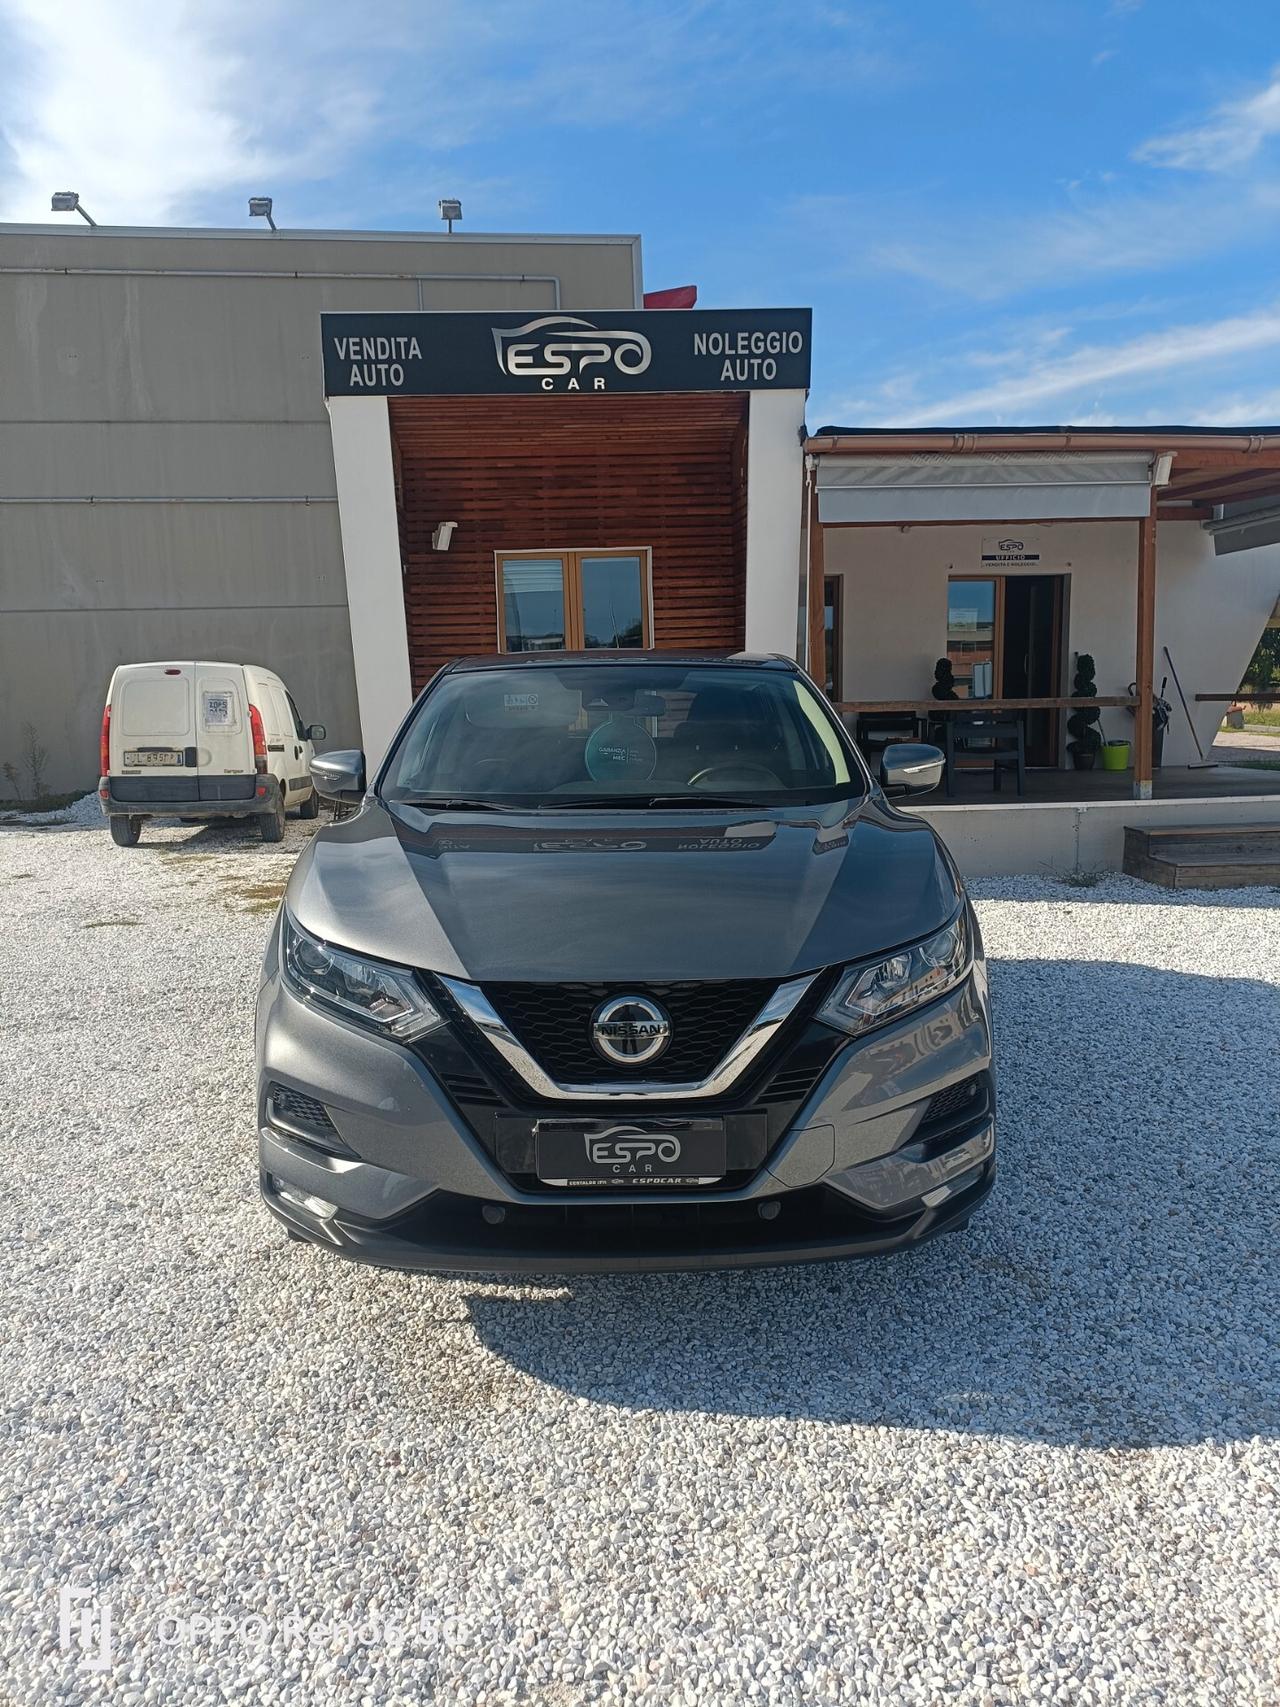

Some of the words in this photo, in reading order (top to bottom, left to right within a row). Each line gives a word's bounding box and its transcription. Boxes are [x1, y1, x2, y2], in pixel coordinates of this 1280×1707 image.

[333, 336, 422, 361] VENDITA
[506, 334, 652, 376] ESPO
[694, 331, 803, 356] NOLEGGIO
[349, 363, 405, 387] AUTO
[720, 358, 777, 382] AUTO
[541, 377, 606, 390] CAR
[601, 1024, 660, 1036] NISSAN
[592, 1139, 681, 1164] ESPO
[612, 1164, 652, 1173] CAR
